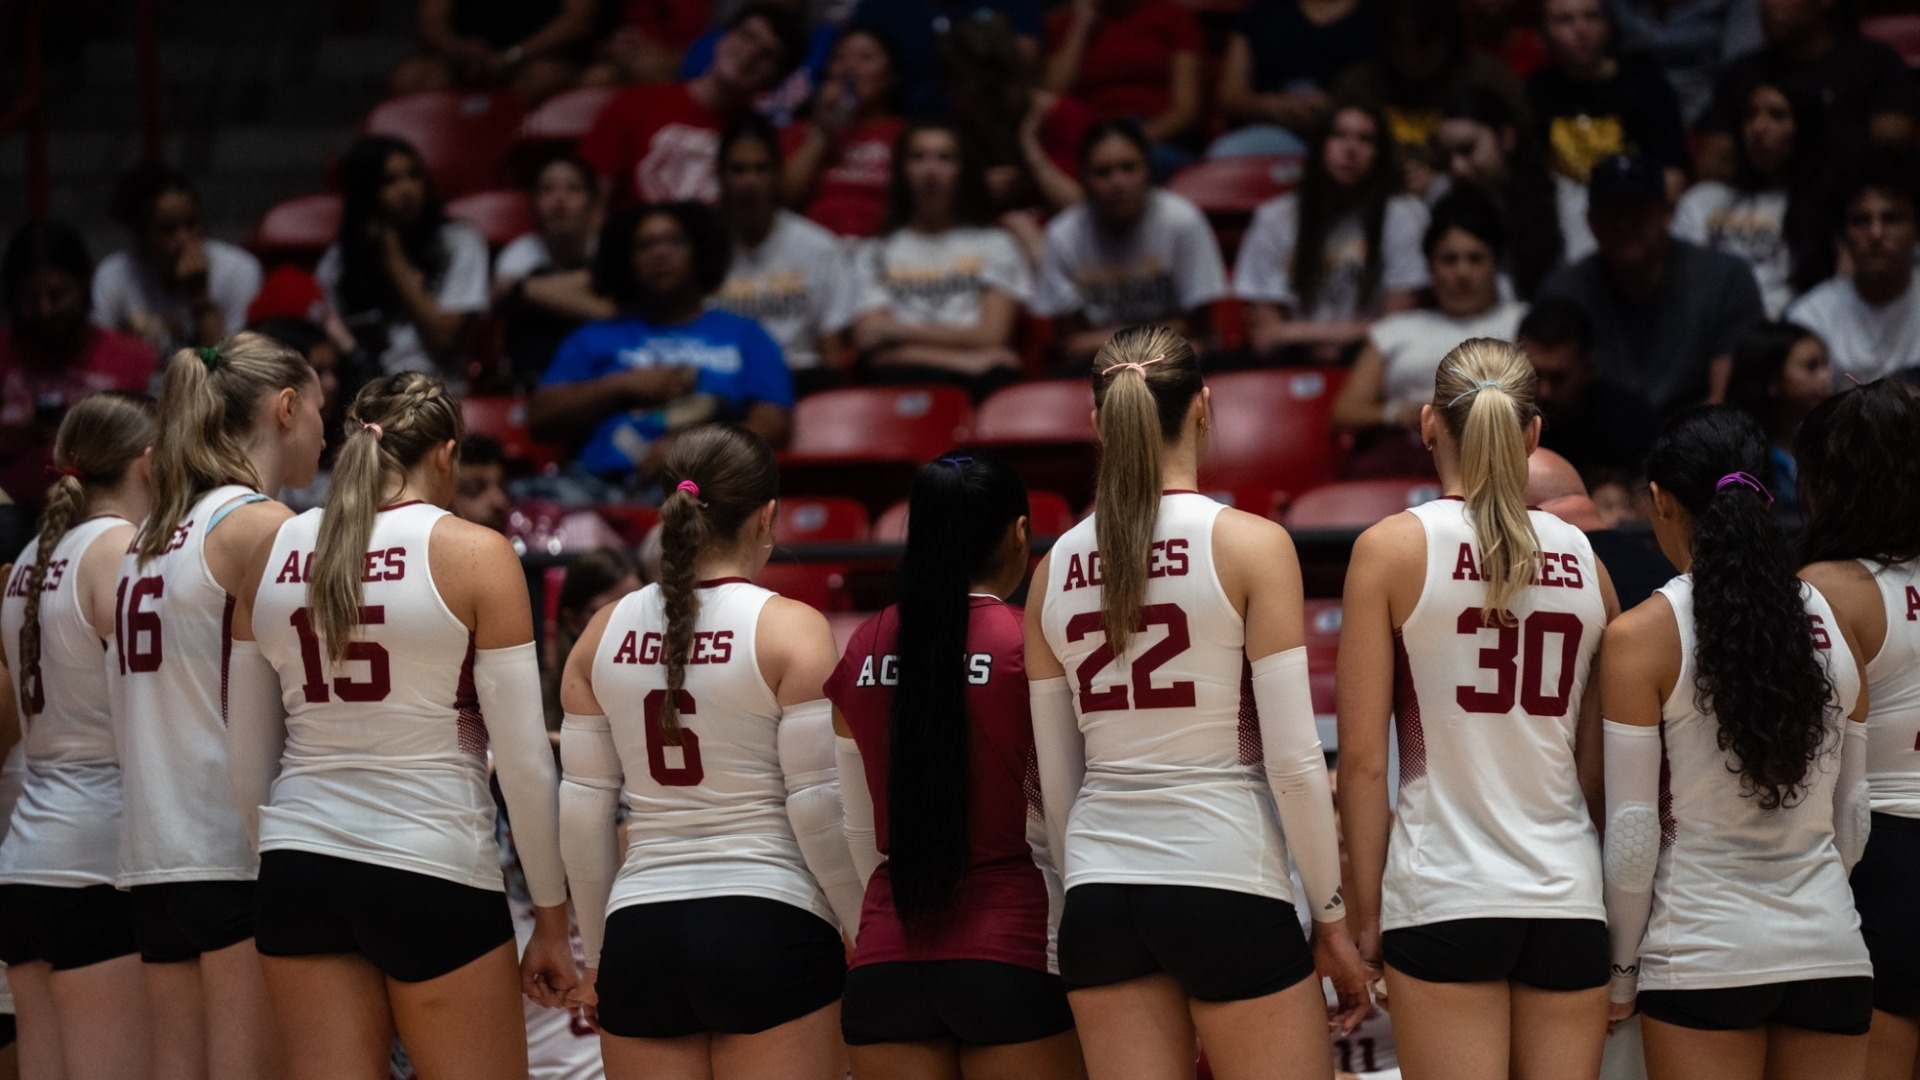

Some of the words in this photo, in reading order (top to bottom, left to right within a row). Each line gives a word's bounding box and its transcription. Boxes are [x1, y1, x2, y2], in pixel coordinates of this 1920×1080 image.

[276, 546, 406, 583] AES
[1063, 539, 1189, 592] AGES
[116, 575, 164, 676] 16
[290, 605, 391, 702] 15
[613, 630, 734, 665] AGES
[856, 653, 993, 687] AGS
[1066, 603, 1196, 714] 22
[1456, 607, 1583, 717] 30
[643, 689, 704, 786] 6
